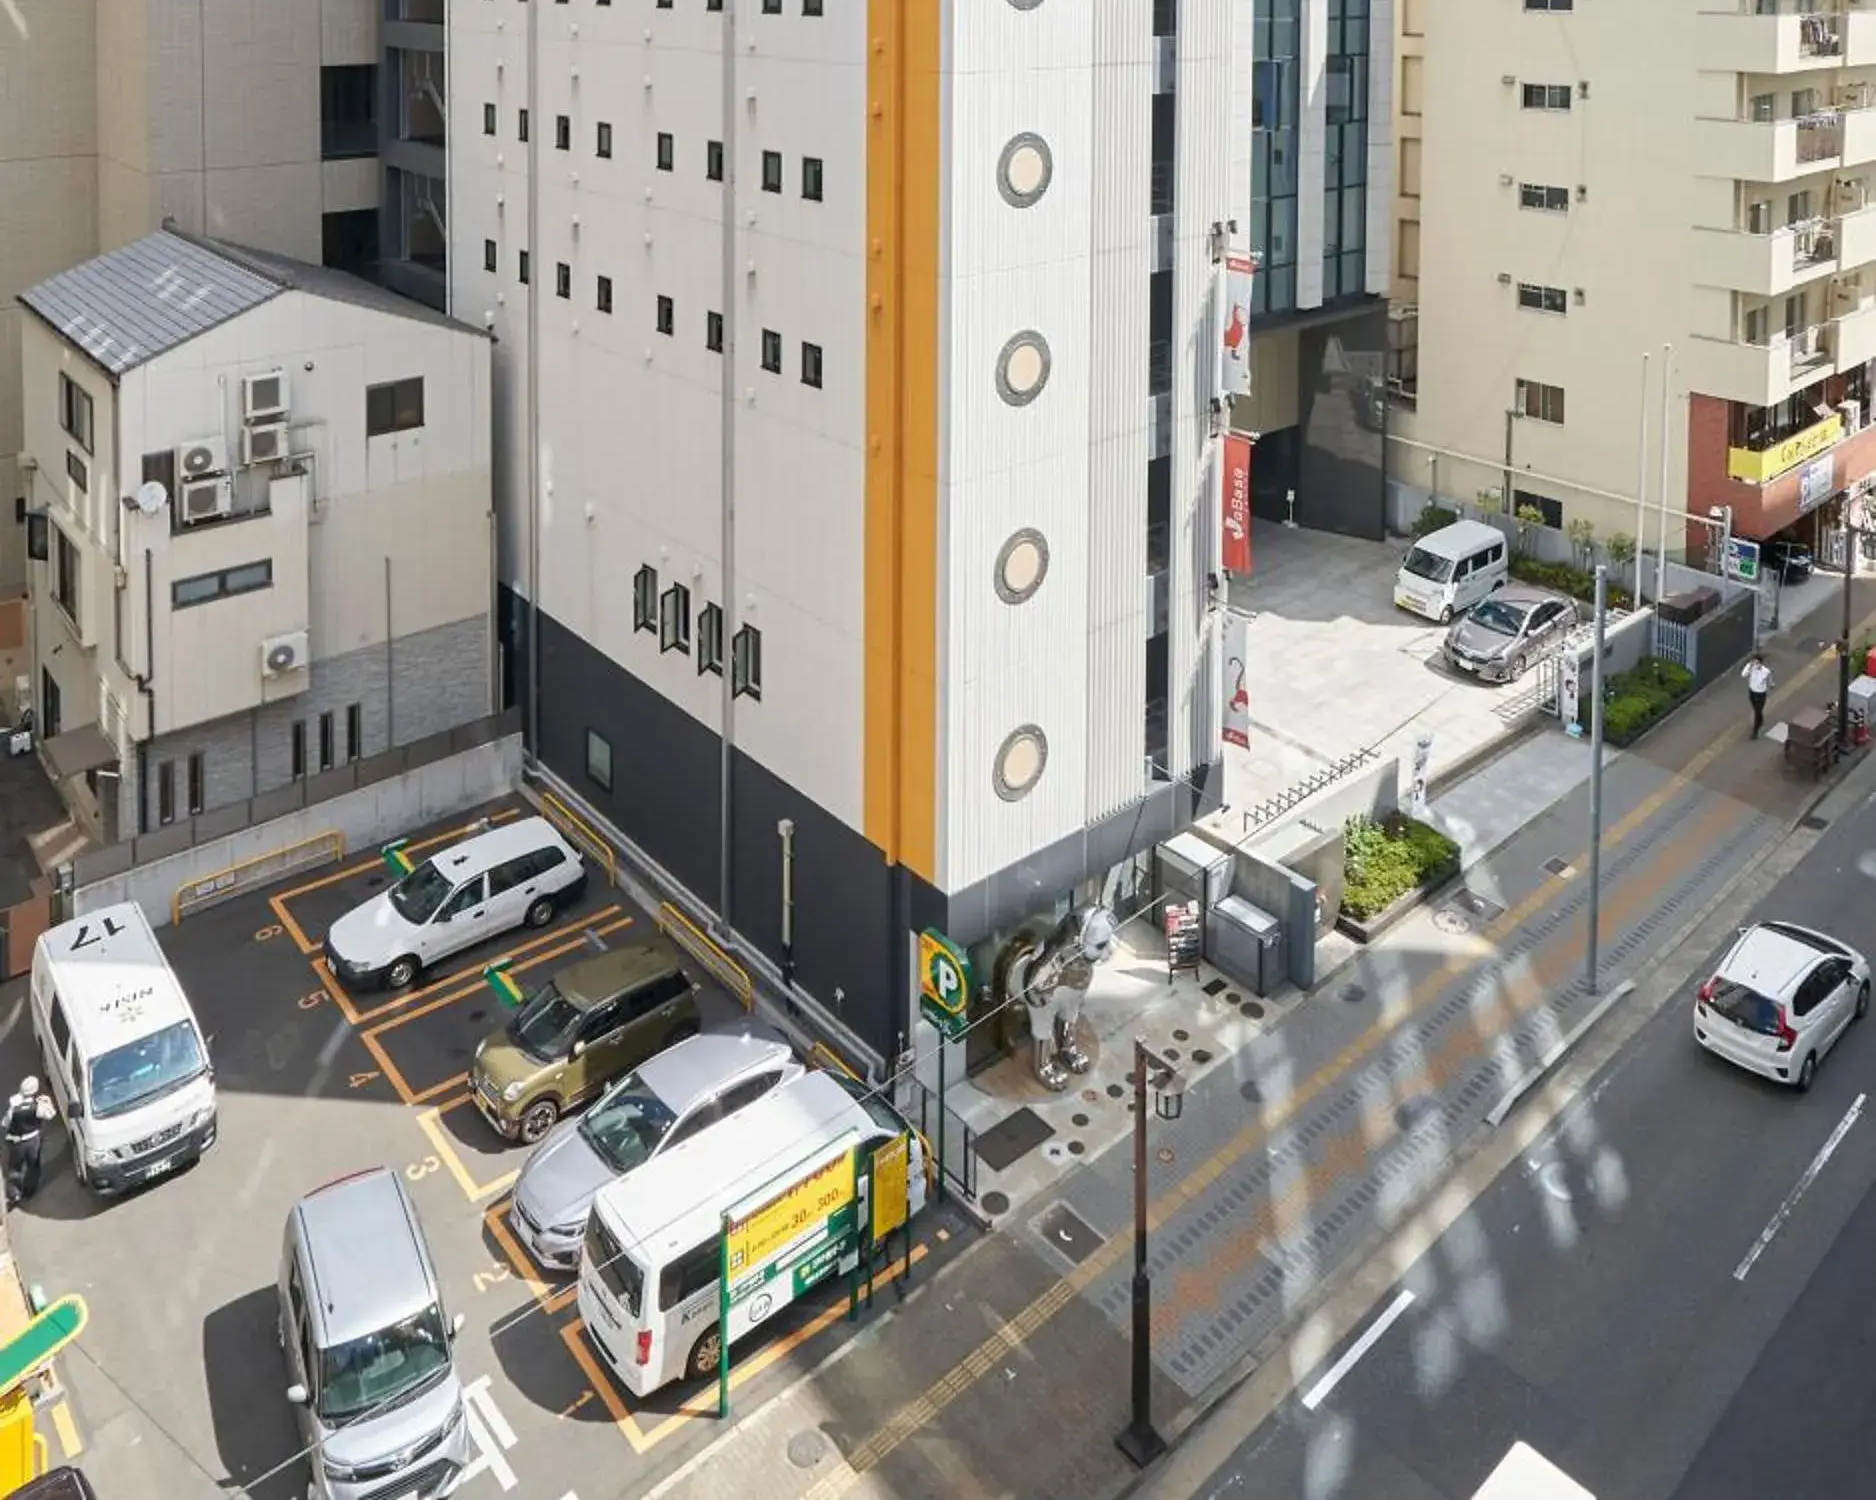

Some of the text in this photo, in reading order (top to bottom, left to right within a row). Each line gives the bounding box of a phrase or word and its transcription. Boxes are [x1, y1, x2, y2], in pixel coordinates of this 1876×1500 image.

[69, 916, 126, 951] 17
[939, 959, 958, 999] P
[298, 990, 329, 1009] 5
[349, 1071, 381, 1088] 4
[406, 1156, 441, 1181] 3
[473, 1262, 511, 1293] 2
